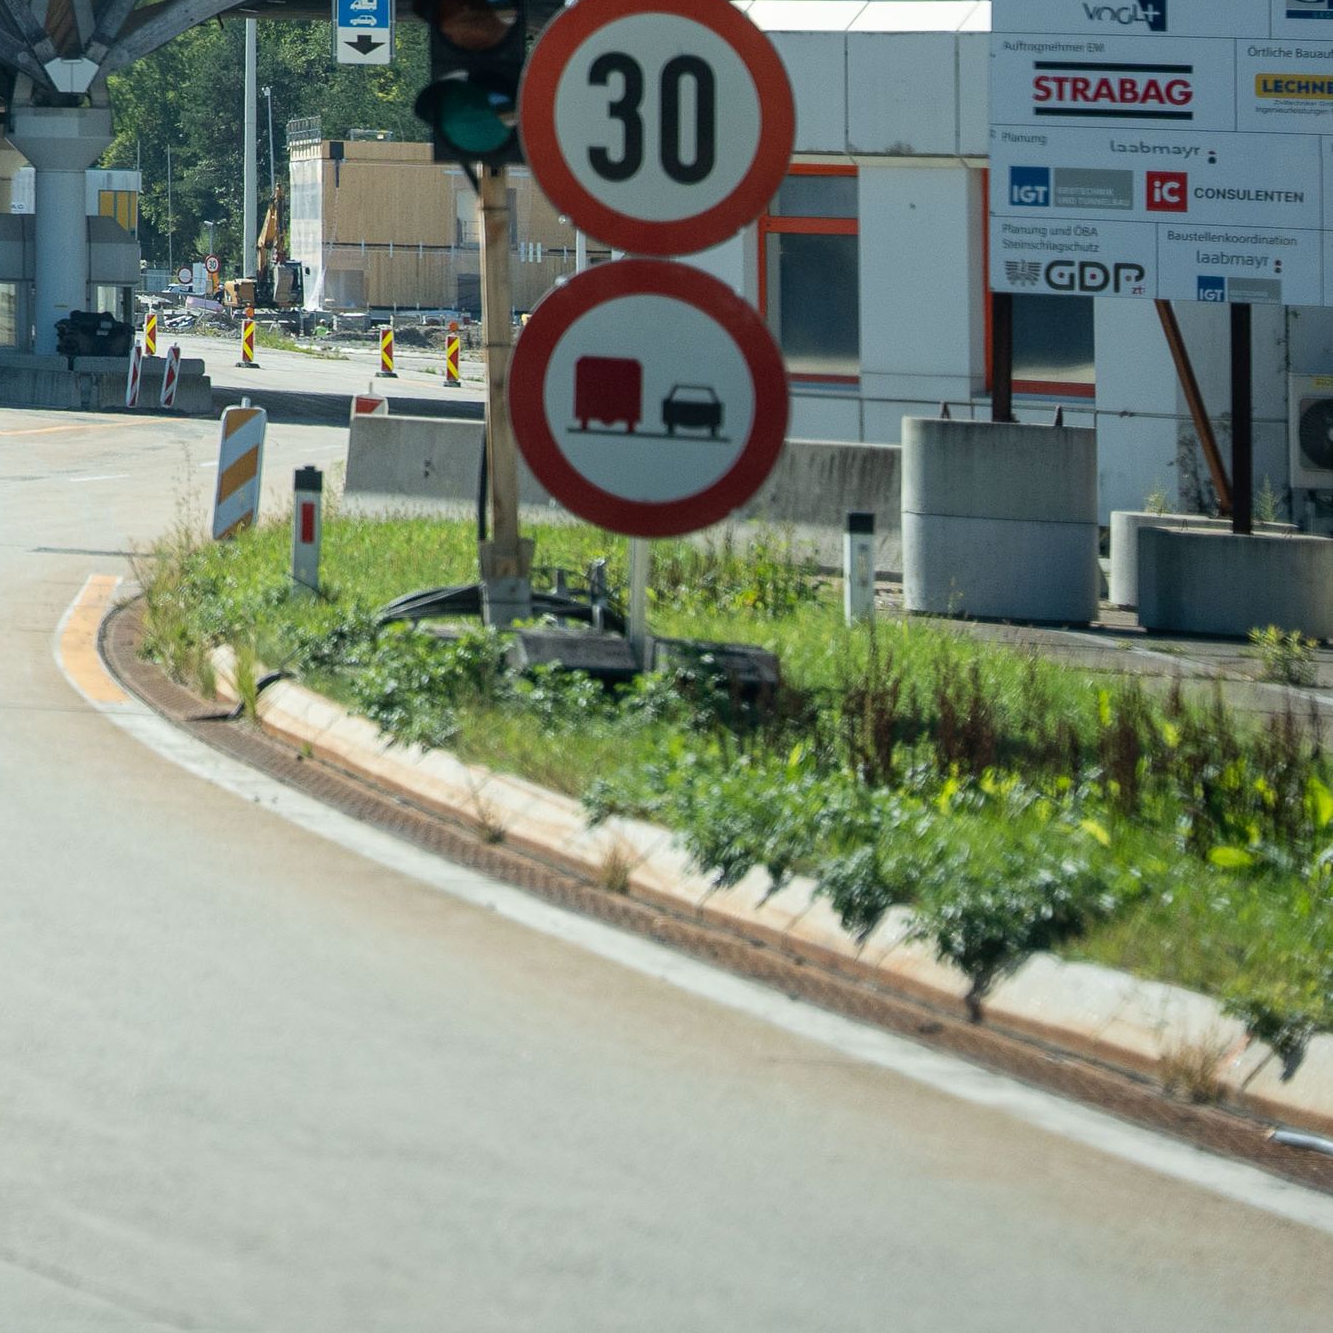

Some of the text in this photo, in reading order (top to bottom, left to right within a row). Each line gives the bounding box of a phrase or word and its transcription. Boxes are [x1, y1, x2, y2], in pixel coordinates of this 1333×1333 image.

[1247, 45, 1293, 58] Örtliche
[1033, 75, 1194, 106] STRABAG
[1262, 79, 1333, 95] LECHNE
[588, 50, 716, 186] 30
[1001, 131, 1047, 145] Planung
[1110, 140, 1200, 159] laabmayr
[1013, 185, 1047, 204] IGT
[1193, 187, 1304, 203] CONSULENTEN
[1002, 223, 1047, 238] Planung
[1050, 225, 1071, 236] und
[1167, 230, 1297, 246] Baustellenkoordination
[1002, 238, 1100, 253] Steinschlagschutz
[208, 259, 217, 270] 30
[1196, 250, 1269, 269] laabmayr
[1044, 259, 1145, 294] GDP
[1199, 288, 1224, 302] IGT
